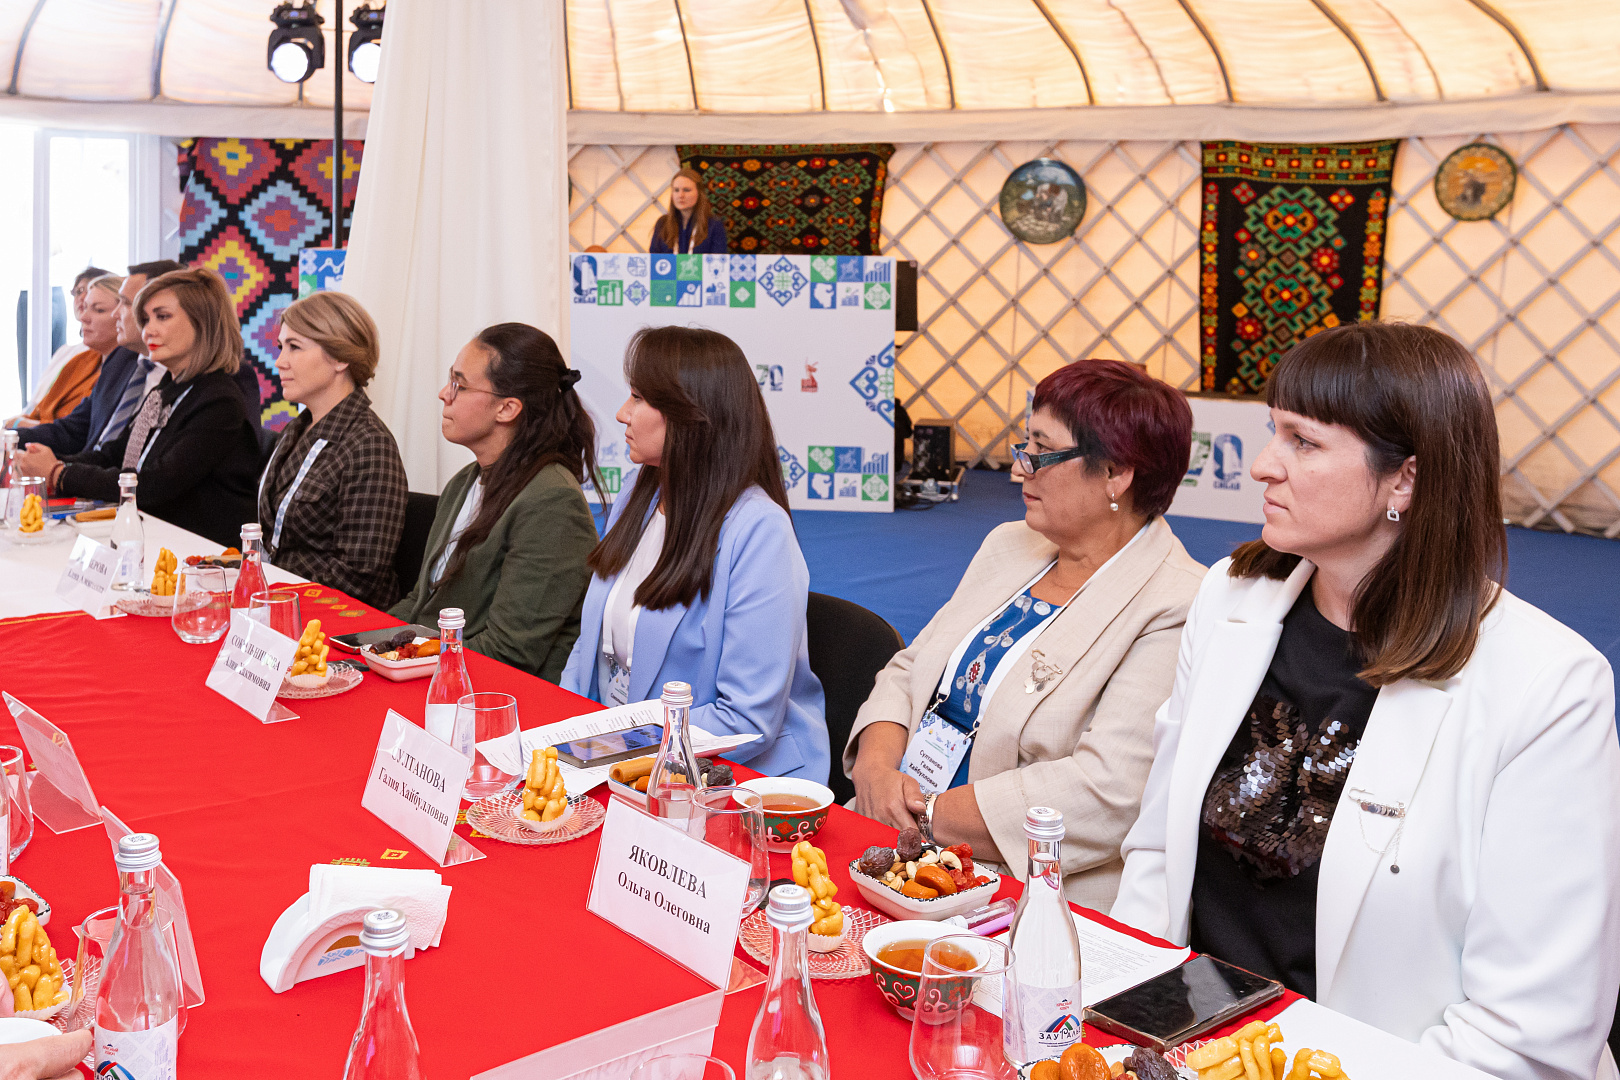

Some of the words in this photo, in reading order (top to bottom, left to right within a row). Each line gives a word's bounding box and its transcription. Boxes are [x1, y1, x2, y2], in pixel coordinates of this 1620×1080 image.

[231, 634, 281, 671] СОКЛЬНИОВА
[908, 762, 938, 788] Хайбулловна
[919, 749, 943, 770] Султанова
[920, 760, 934, 774] Галия
[378, 766, 400, 792] Галия
[399, 781, 449, 827] Хайбулловна
[628, 844, 707, 899] ЯКОВЛЕВА
[618, 871, 651, 901] Ольга
[654, 891, 711, 934] Олеговна
